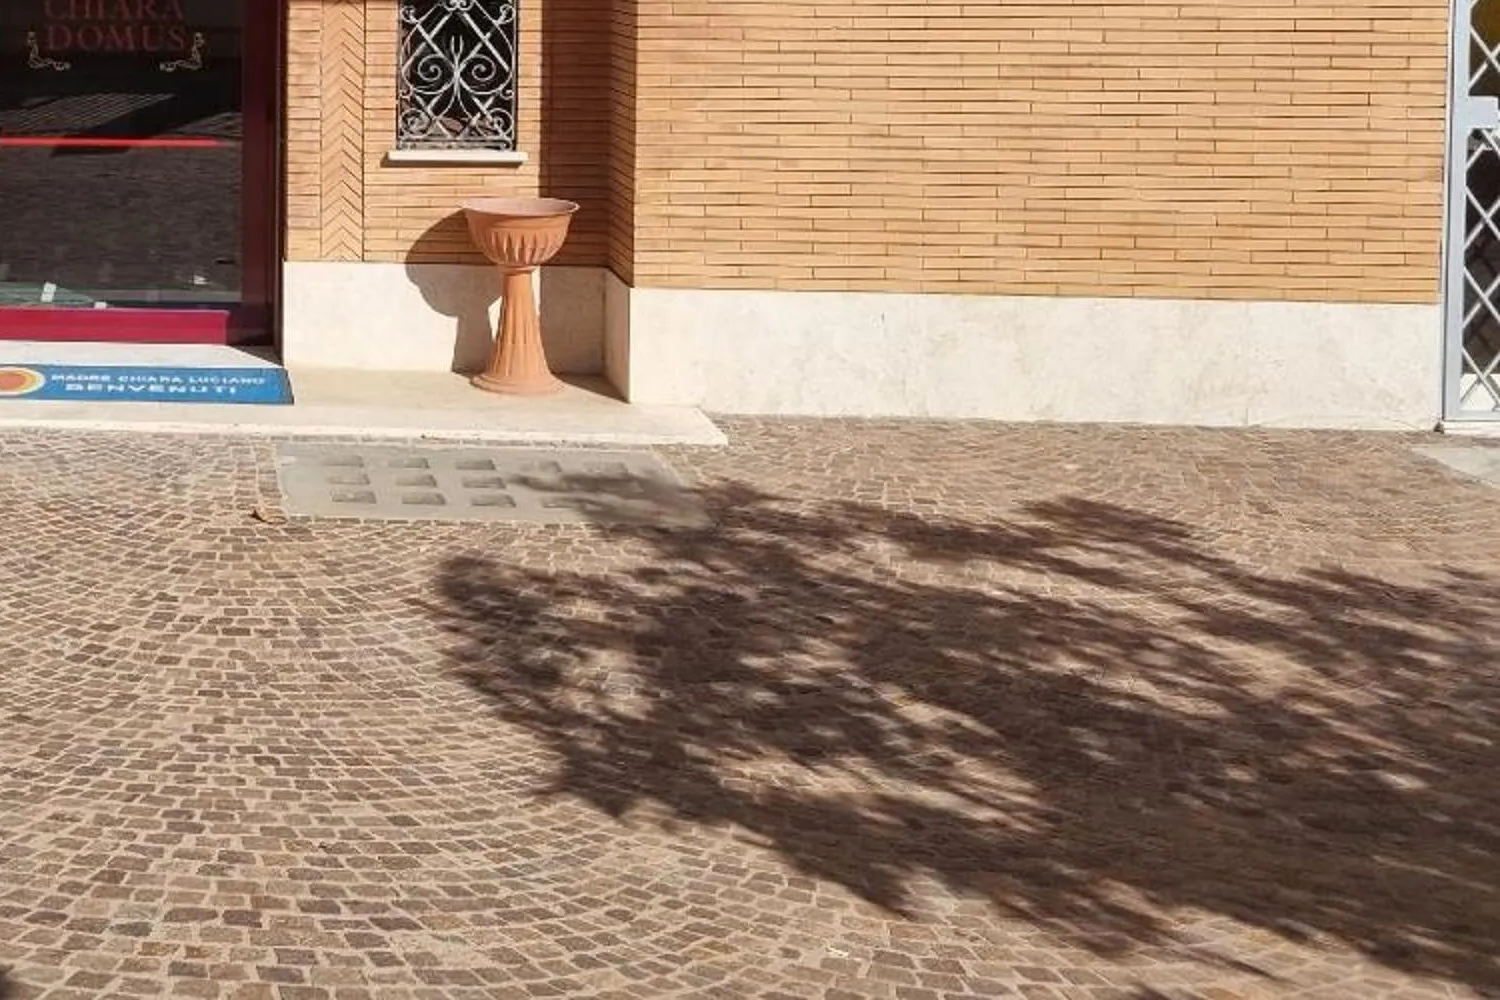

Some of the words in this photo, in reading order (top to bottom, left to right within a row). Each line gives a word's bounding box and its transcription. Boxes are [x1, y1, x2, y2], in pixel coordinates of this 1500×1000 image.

[48, 24, 185, 51] DOMUS
[51, 373, 111, 382] MADRE
[117, 375, 182, 384] CHIARA
[188, 377, 265, 386] LUCIANO
[65, 383, 237, 394] BENVENUTI
